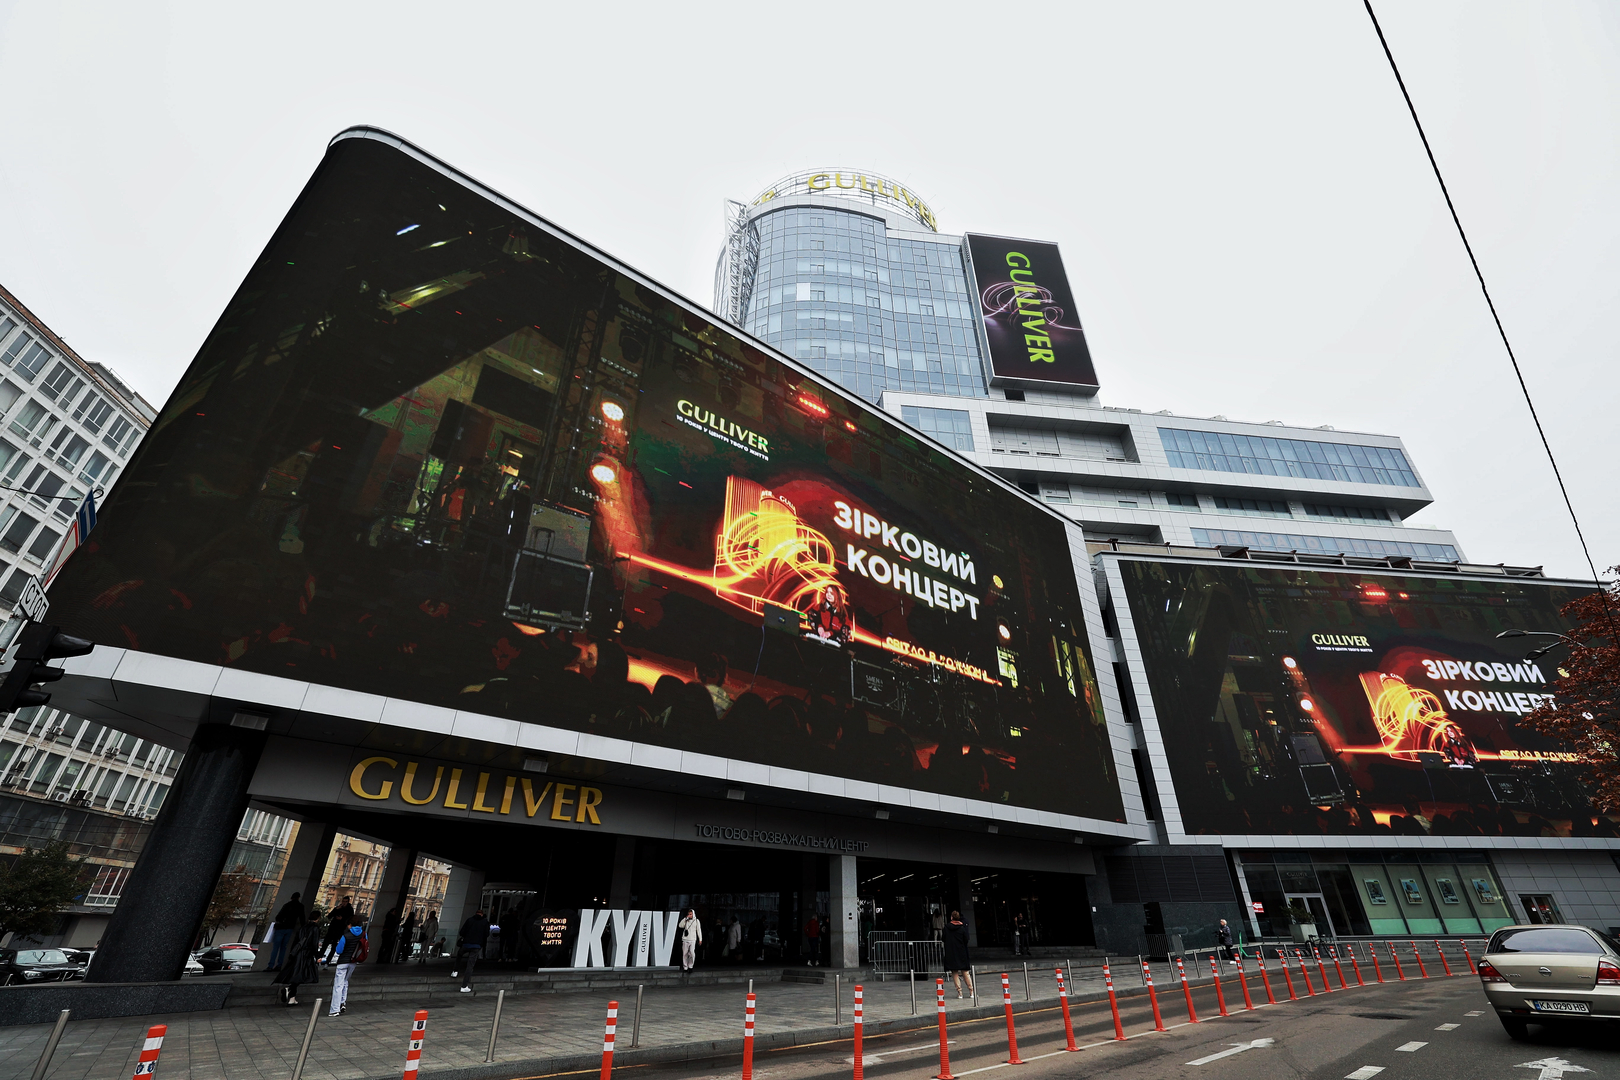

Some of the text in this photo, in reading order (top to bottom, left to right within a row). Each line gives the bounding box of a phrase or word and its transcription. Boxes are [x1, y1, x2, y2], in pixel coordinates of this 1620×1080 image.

[807, 173, 938, 232] GULLIVER
[1005, 251, 1055, 363] GULLIVER
[677, 399, 769, 453] GULLIVER
[833, 501, 977, 585] ЗІРКОВИЙ
[1207, 530, 1320, 549] MERCATO
[847, 543, 980, 620] КОНЦЕРТ
[1312, 633, 1370, 647] GULLIVER
[1422, 659, 1546, 684] ЗІРКОВИЙ
[1444, 690, 1558, 716] КОНЦЕРТ
[350, 756, 602, 824] GULLIVER
[696, 823, 869, 853] ТОРГОВО-РОЗВАЖАЛЬНИЙ ЦЕНТР
[573, 909, 680, 968] KYIV
[1553, 1003, 1572, 1011] 0290
